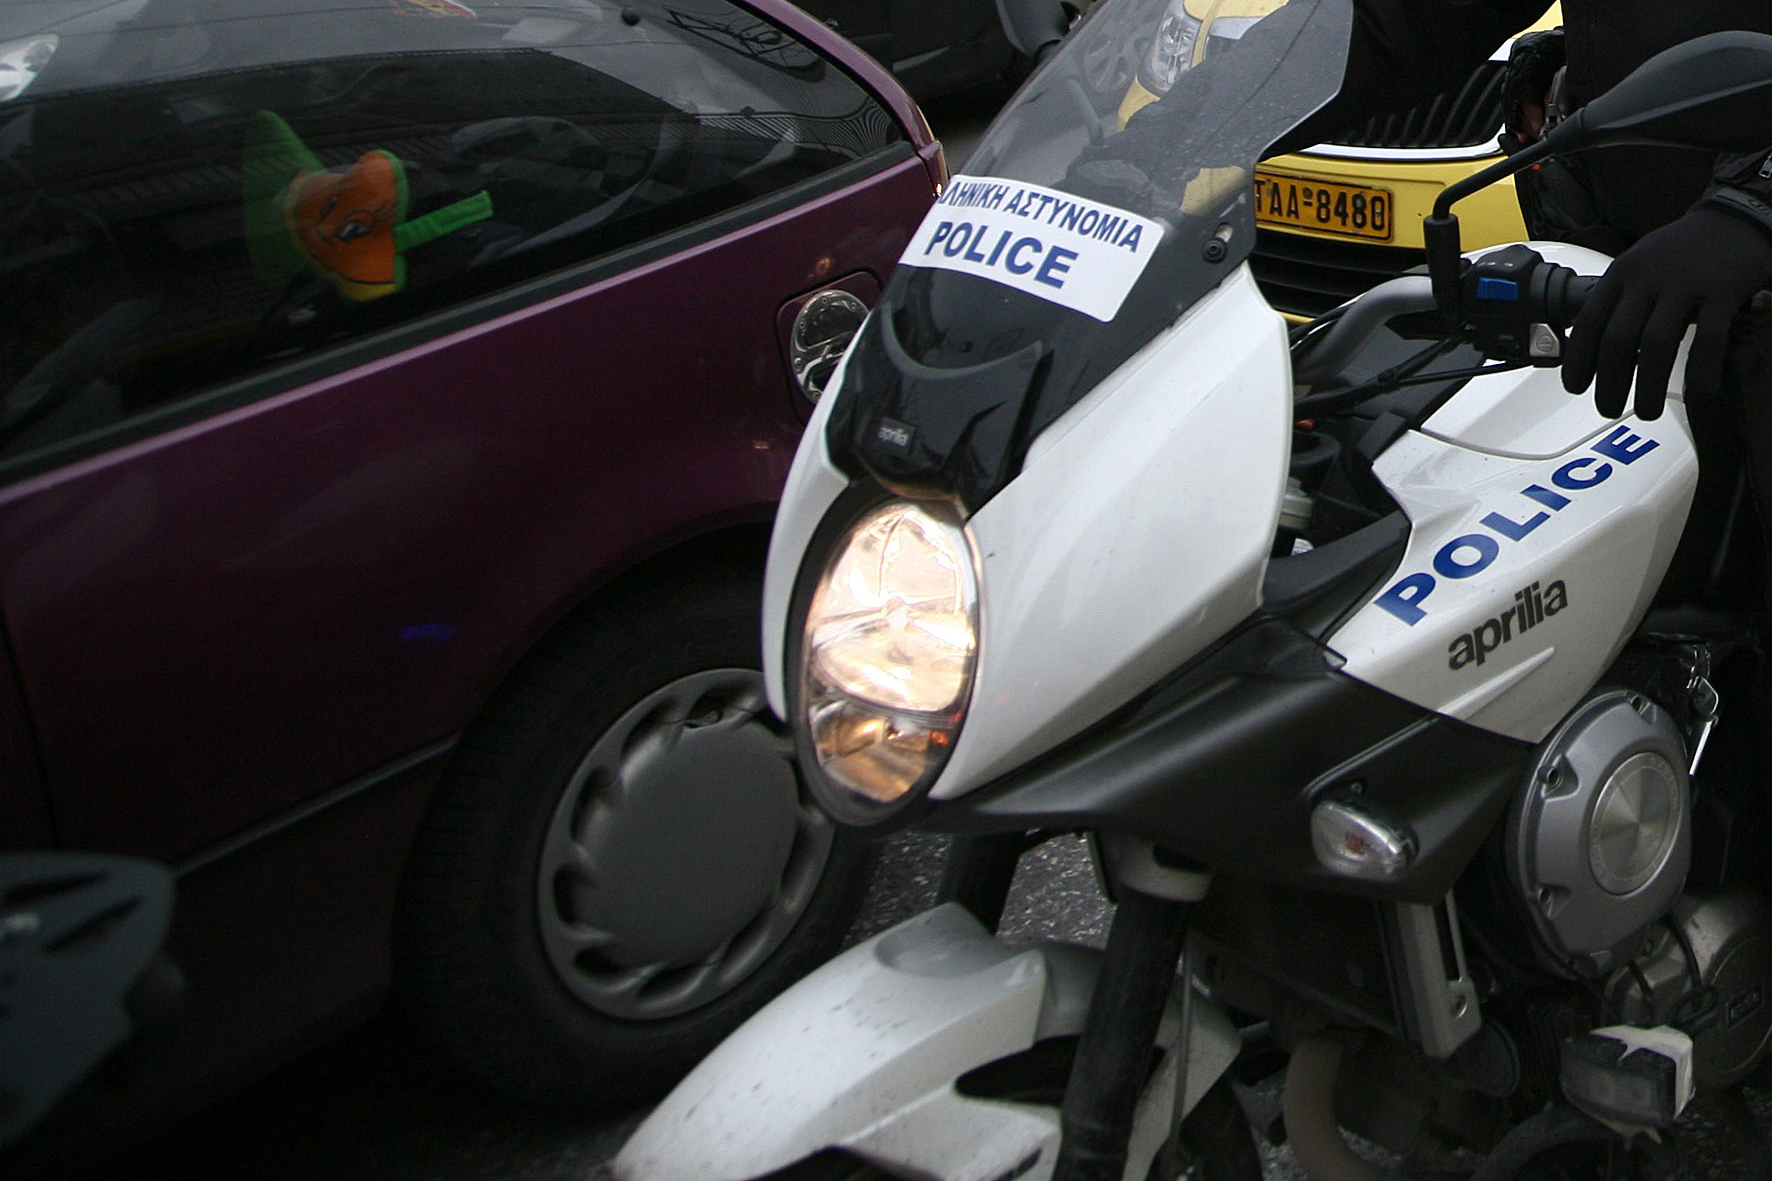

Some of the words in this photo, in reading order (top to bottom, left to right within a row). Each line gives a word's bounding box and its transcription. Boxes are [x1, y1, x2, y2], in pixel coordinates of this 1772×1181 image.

[923, 220, 1079, 290] POLICE
[1003, 189, 1144, 253] ΑΣΤΥΝΟΜΙΑ
[1372, 424, 1661, 627] POLICE
[1448, 579, 1568, 671] aprilia
